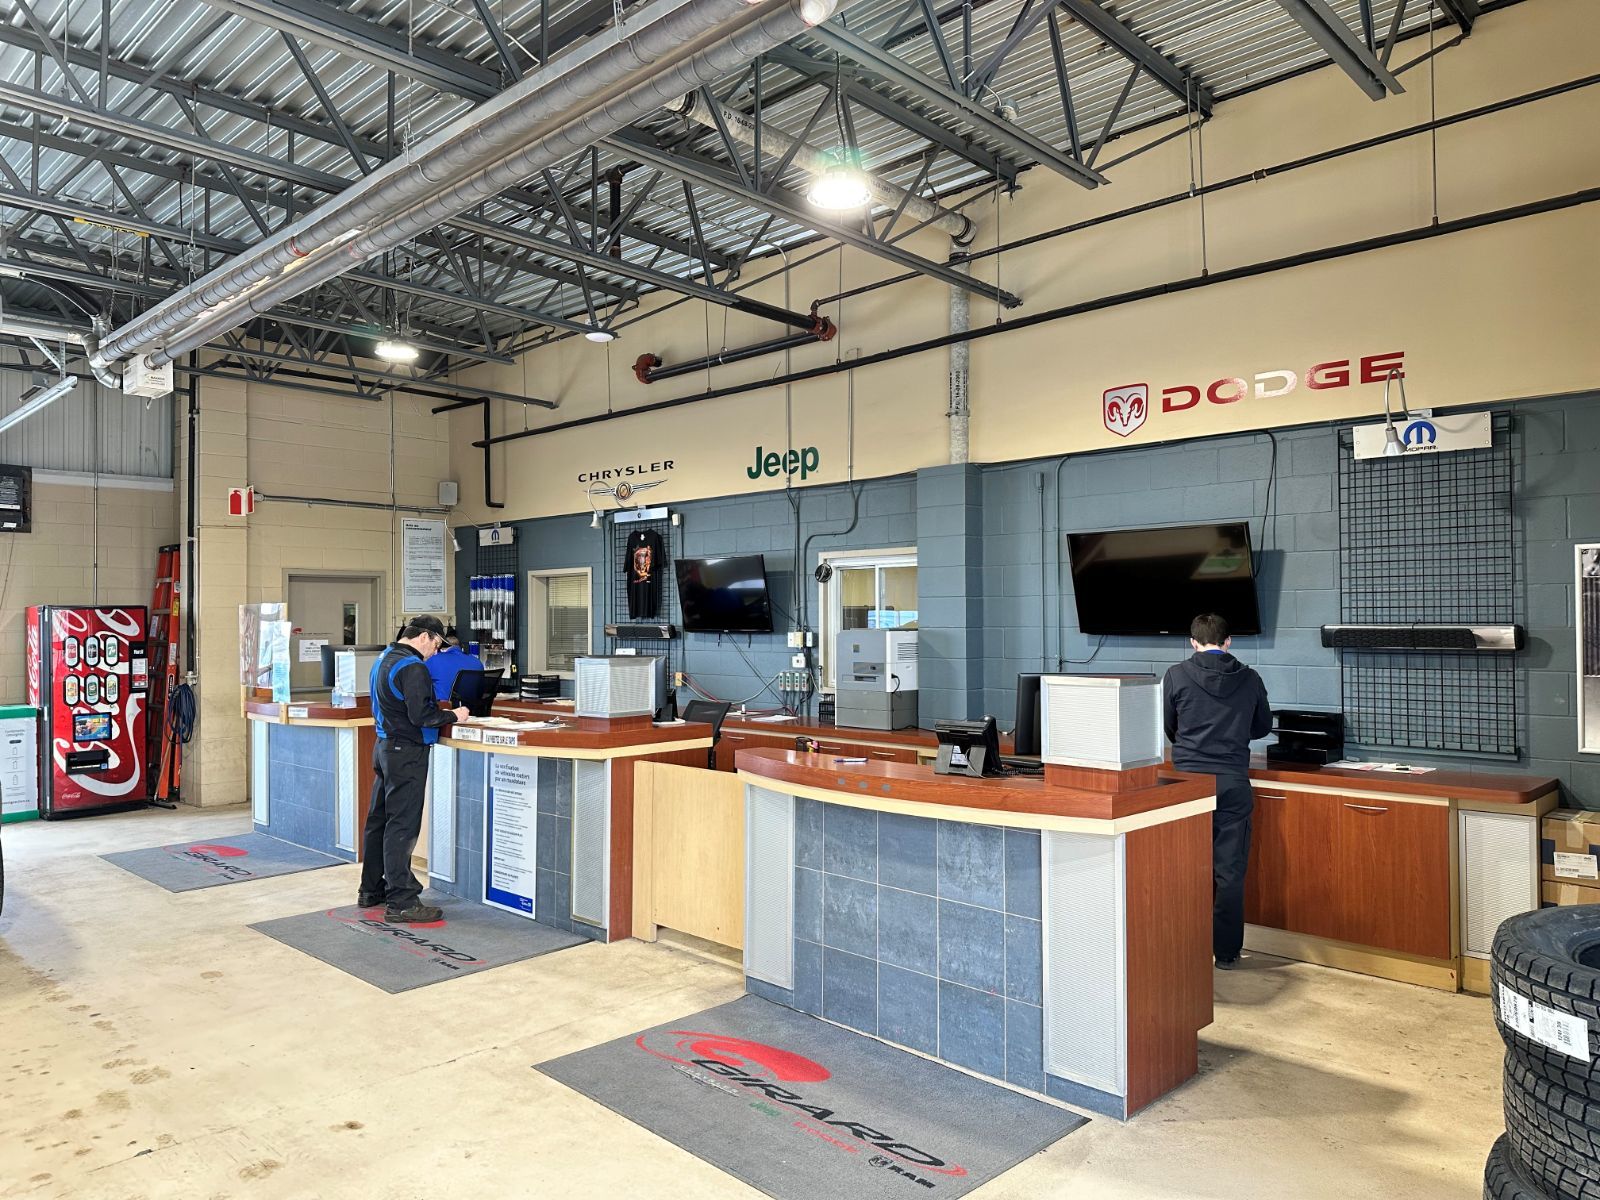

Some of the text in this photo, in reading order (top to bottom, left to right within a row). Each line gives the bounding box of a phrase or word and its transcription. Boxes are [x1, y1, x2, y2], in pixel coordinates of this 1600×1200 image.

[1161, 351, 1406, 413] DODGE
[578, 460, 675, 483] CHRYSLER
[746, 446, 820, 480] Jeep
[690, 1058, 946, 1167] GIRARD
[887, 1165, 937, 1189] RAM
